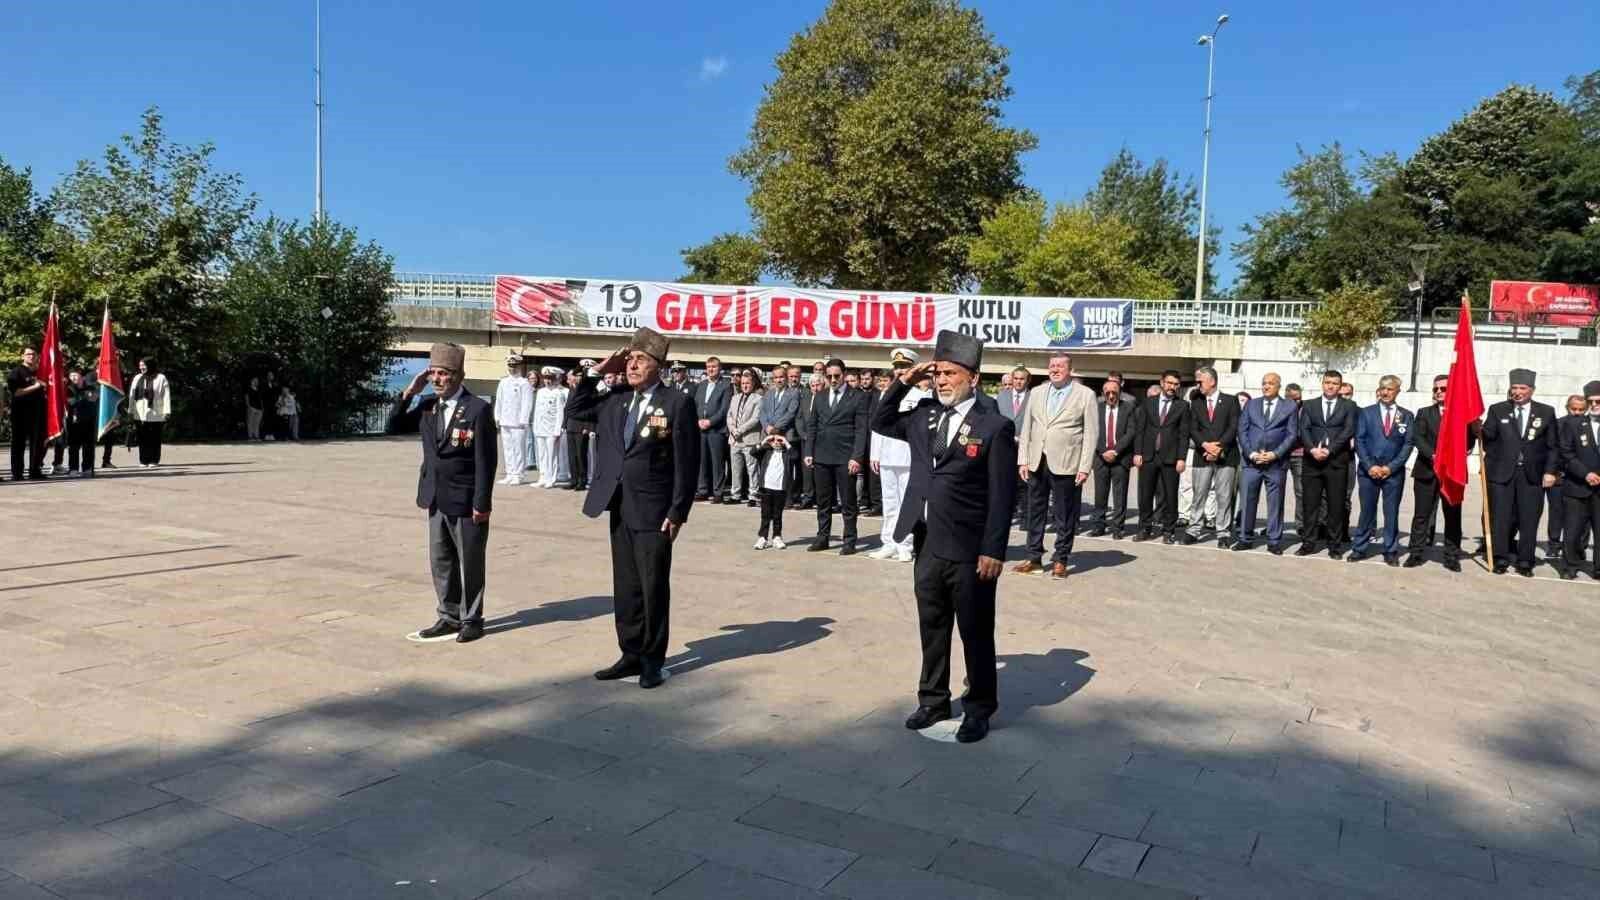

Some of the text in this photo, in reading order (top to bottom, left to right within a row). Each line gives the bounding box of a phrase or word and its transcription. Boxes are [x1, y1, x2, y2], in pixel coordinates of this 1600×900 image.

[599, 283, 642, 312] 19
[958, 298, 1021, 320] KUTLU
[596, 314, 641, 328] EYLÜL
[656, 288, 935, 341] GAZİLER GÜNÜ
